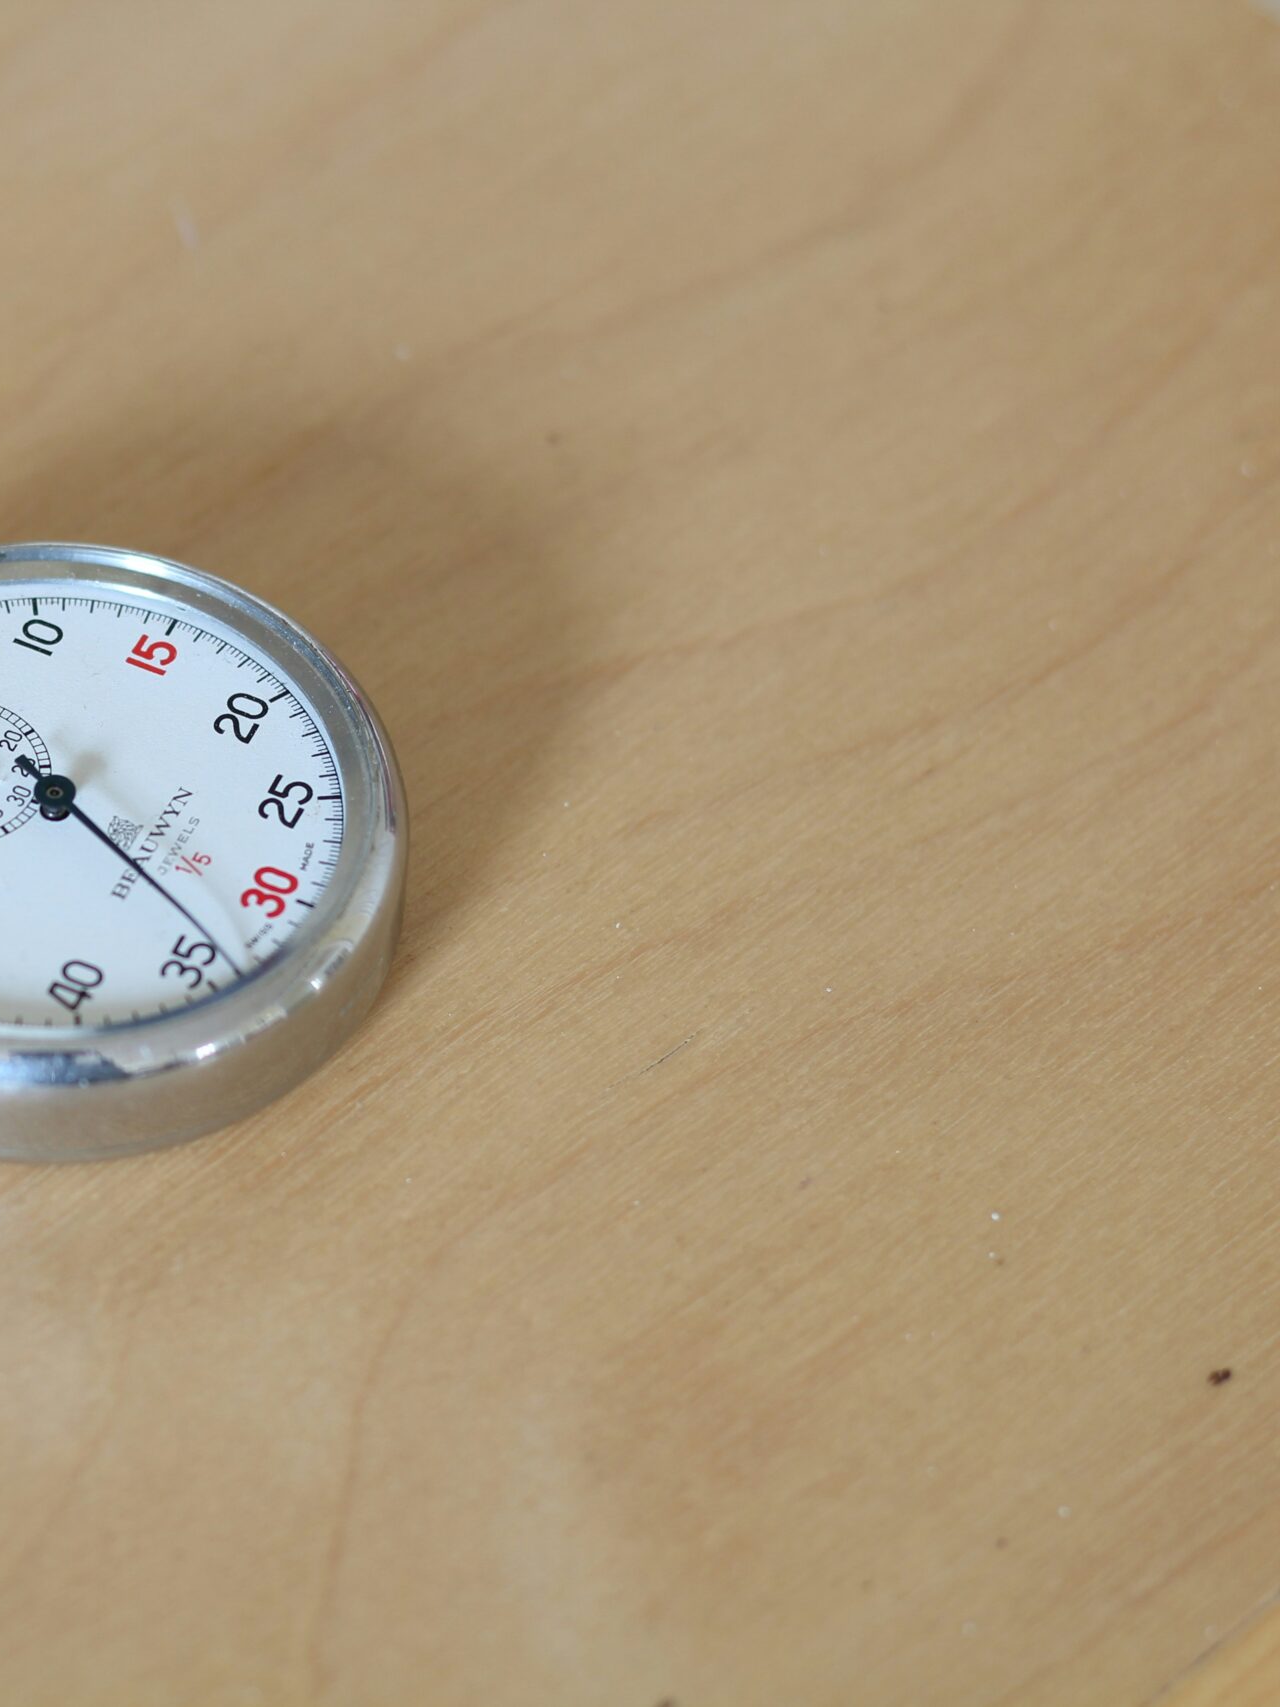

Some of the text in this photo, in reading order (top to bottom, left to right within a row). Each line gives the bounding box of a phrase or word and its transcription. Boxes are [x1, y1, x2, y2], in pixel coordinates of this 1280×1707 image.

[13, 618, 63, 657] 10
[126, 634, 178, 676] 15
[214, 693, 268, 744] 20
[6, 785, 32, 807] 30
[258, 774, 313, 829] 25
[111, 787, 193, 900] BEAUWYN
[157, 816, 200, 875] JEWELS
[175, 852, 211, 876] 1/5
[299, 842, 314, 871] MADE
[240, 866, 298, 919] 30
[48, 959, 104, 1013] 40
[161, 935, 217, 989] 35
